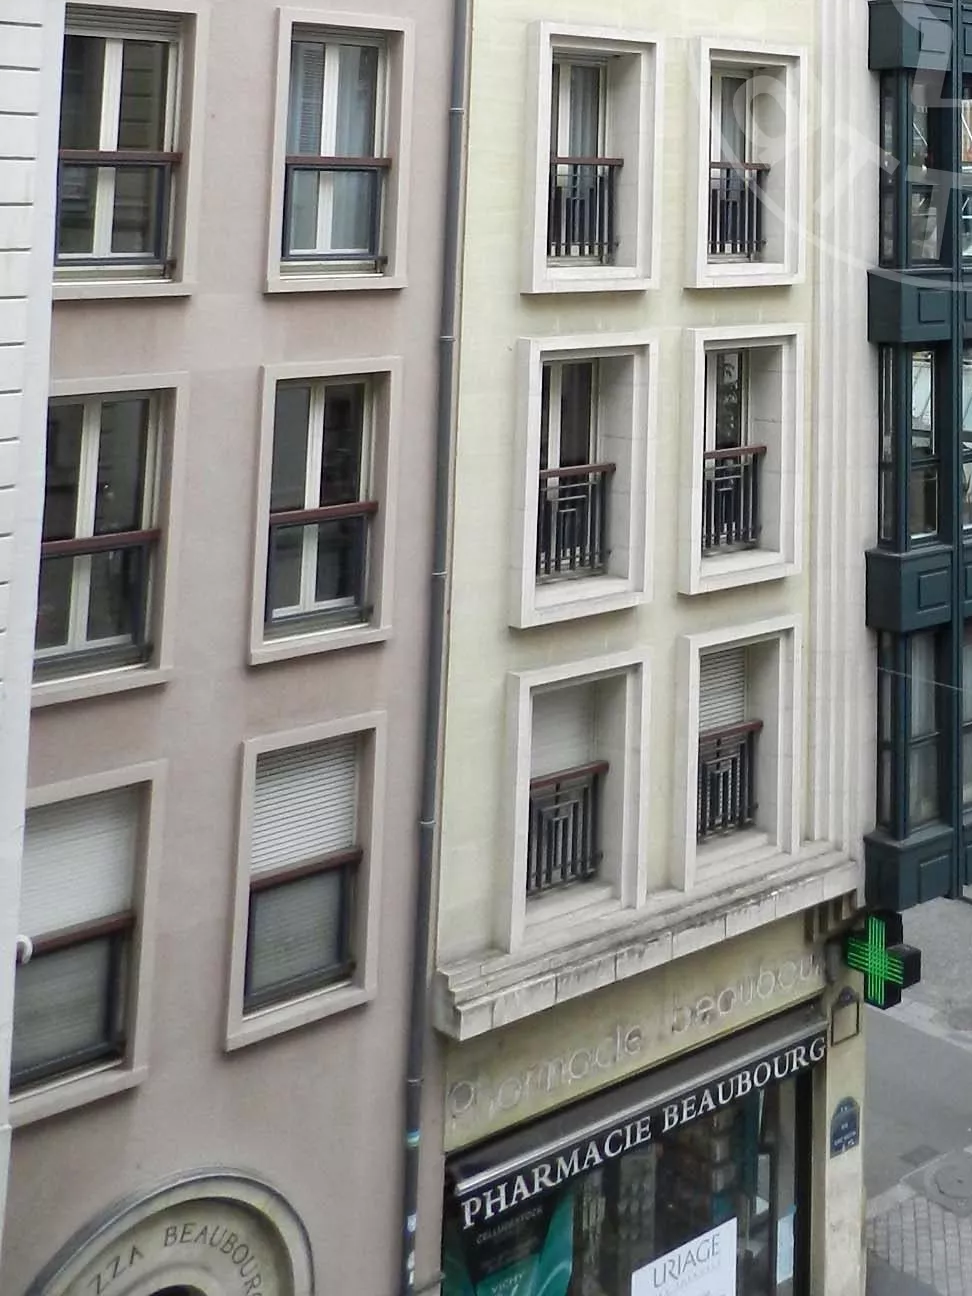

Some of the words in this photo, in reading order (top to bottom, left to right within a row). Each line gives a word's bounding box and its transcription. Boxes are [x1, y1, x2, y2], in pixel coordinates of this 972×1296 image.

[460, 1116, 652, 1230] PHARMACIE
[661, 1036, 827, 1134] BEAUBOURG
[163, 1221, 265, 1296] BEAUBOUR
[653, 1233, 720, 1288] URIAGE
